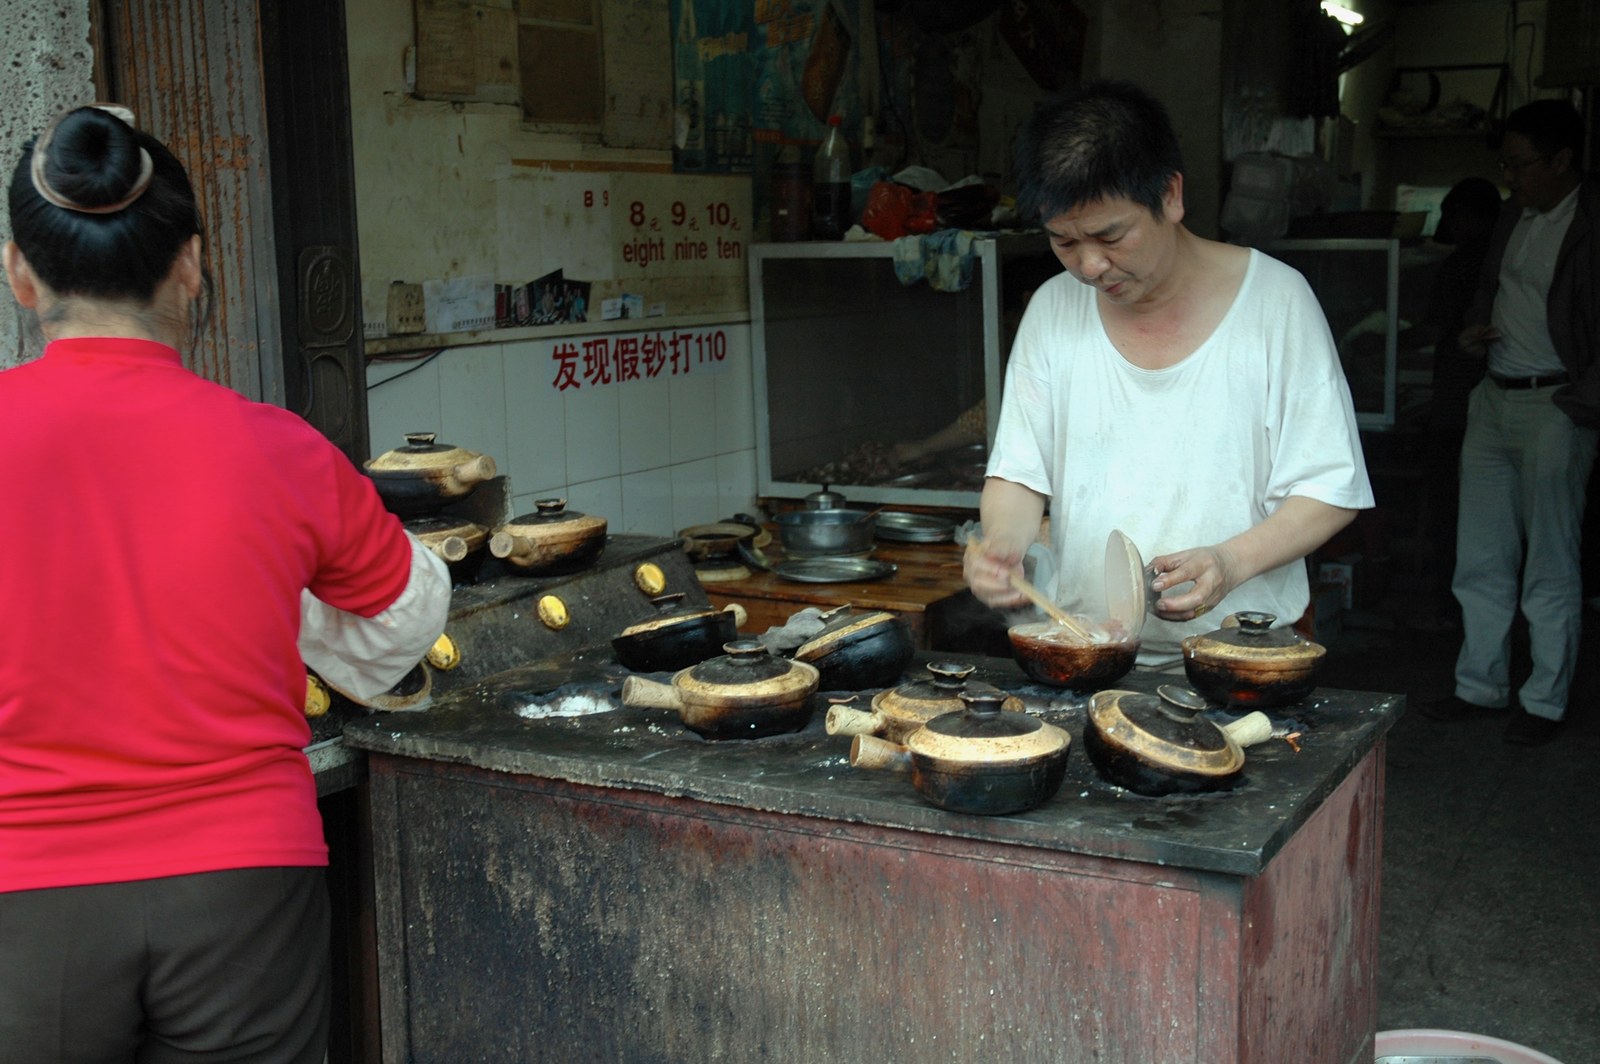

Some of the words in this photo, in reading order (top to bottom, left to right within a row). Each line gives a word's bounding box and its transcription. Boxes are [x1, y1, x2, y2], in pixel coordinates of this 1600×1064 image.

[584, 190, 593, 207] 8
[623, 237, 666, 268] eight
[675, 236, 708, 260] nine
[716, 236, 741, 259] ten
[552, 329, 726, 391] 发现假钞打110
